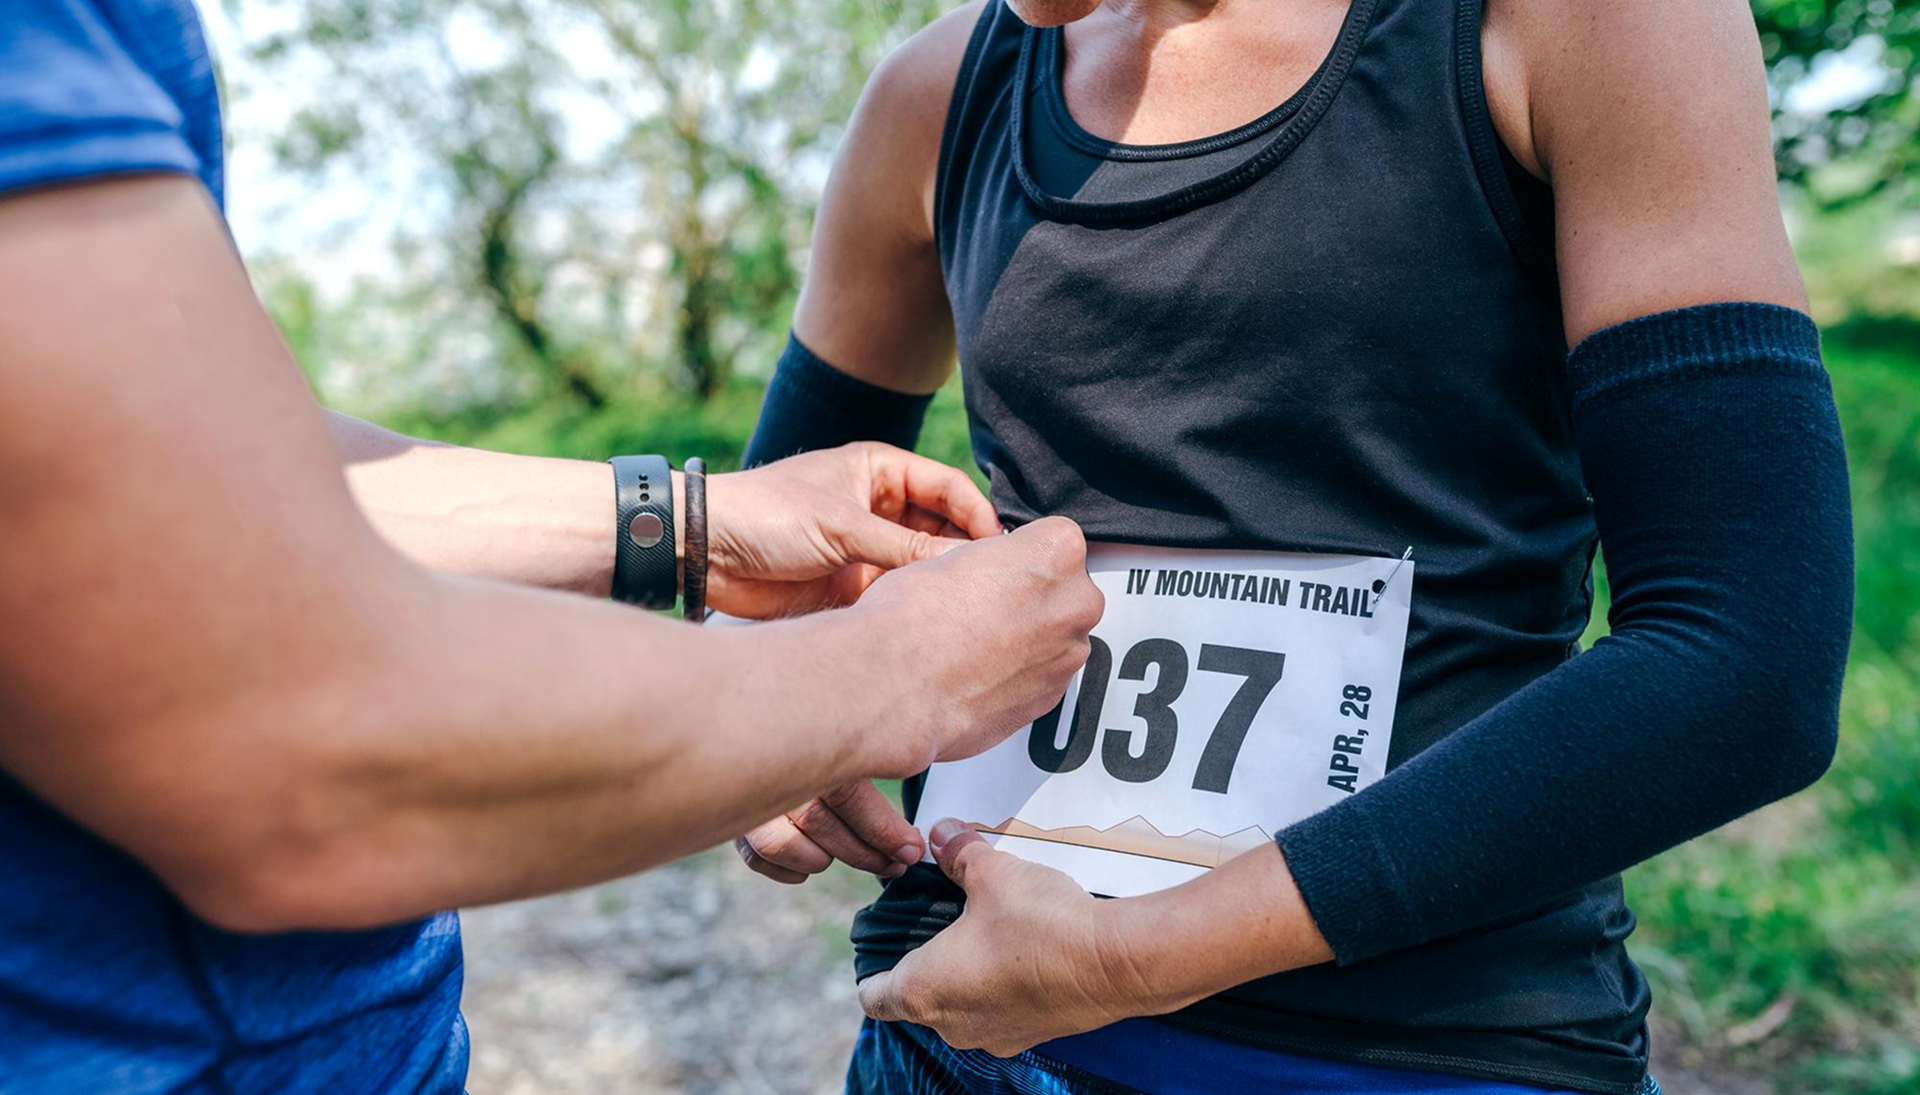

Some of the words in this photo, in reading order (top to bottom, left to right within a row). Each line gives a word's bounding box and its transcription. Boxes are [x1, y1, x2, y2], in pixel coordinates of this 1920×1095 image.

[1126, 568, 1151, 595] IV
[1154, 569, 1291, 606] MOUNTAIN
[1299, 581, 1374, 618] TRAIL
[1028, 635, 1286, 795] 037
[1340, 684, 1372, 720] 28
[1327, 729, 1369, 793] APR,
